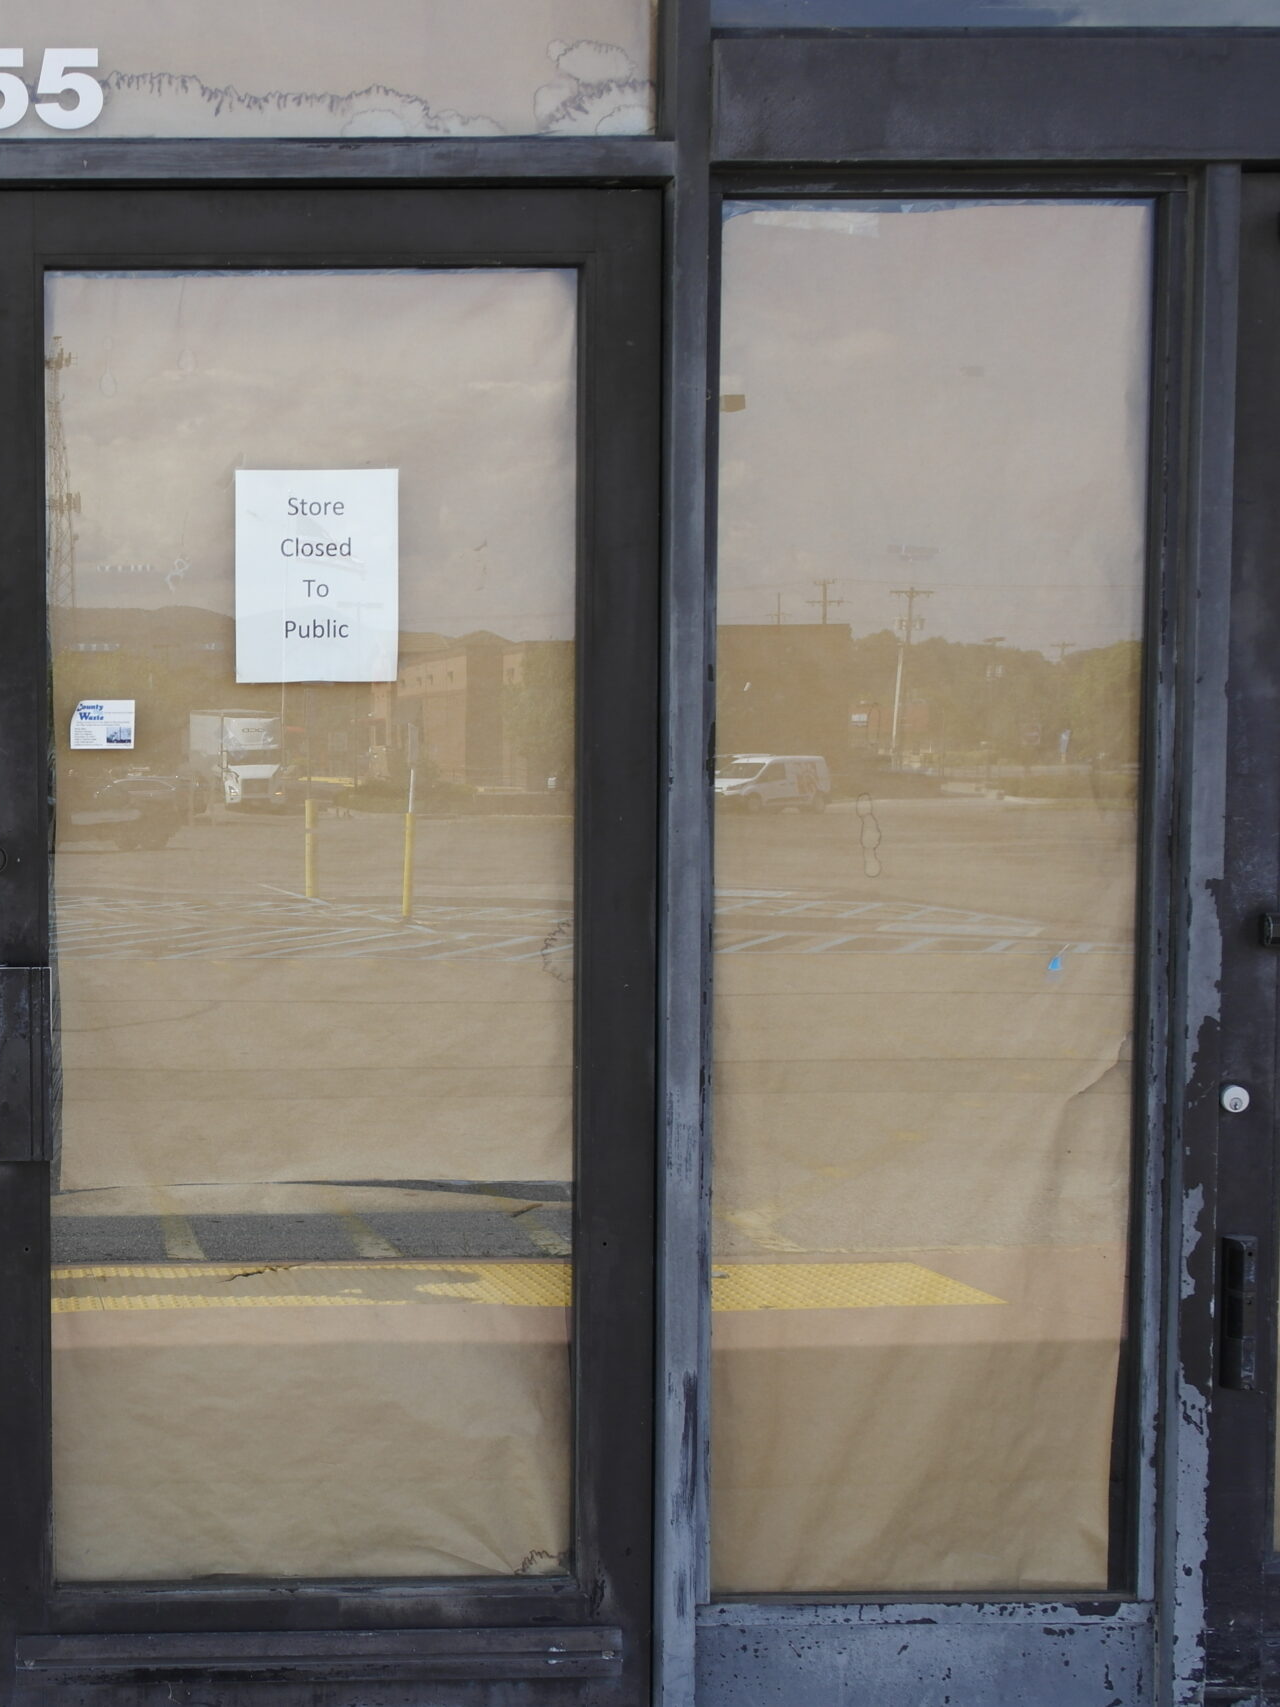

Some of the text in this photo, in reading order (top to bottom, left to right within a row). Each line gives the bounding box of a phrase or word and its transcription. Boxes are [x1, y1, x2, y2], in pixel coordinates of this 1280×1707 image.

[287, 497, 345, 517] Store
[280, 537, 352, 558] Closed
[303, 579, 330, 598] To
[285, 619, 349, 639] Public
